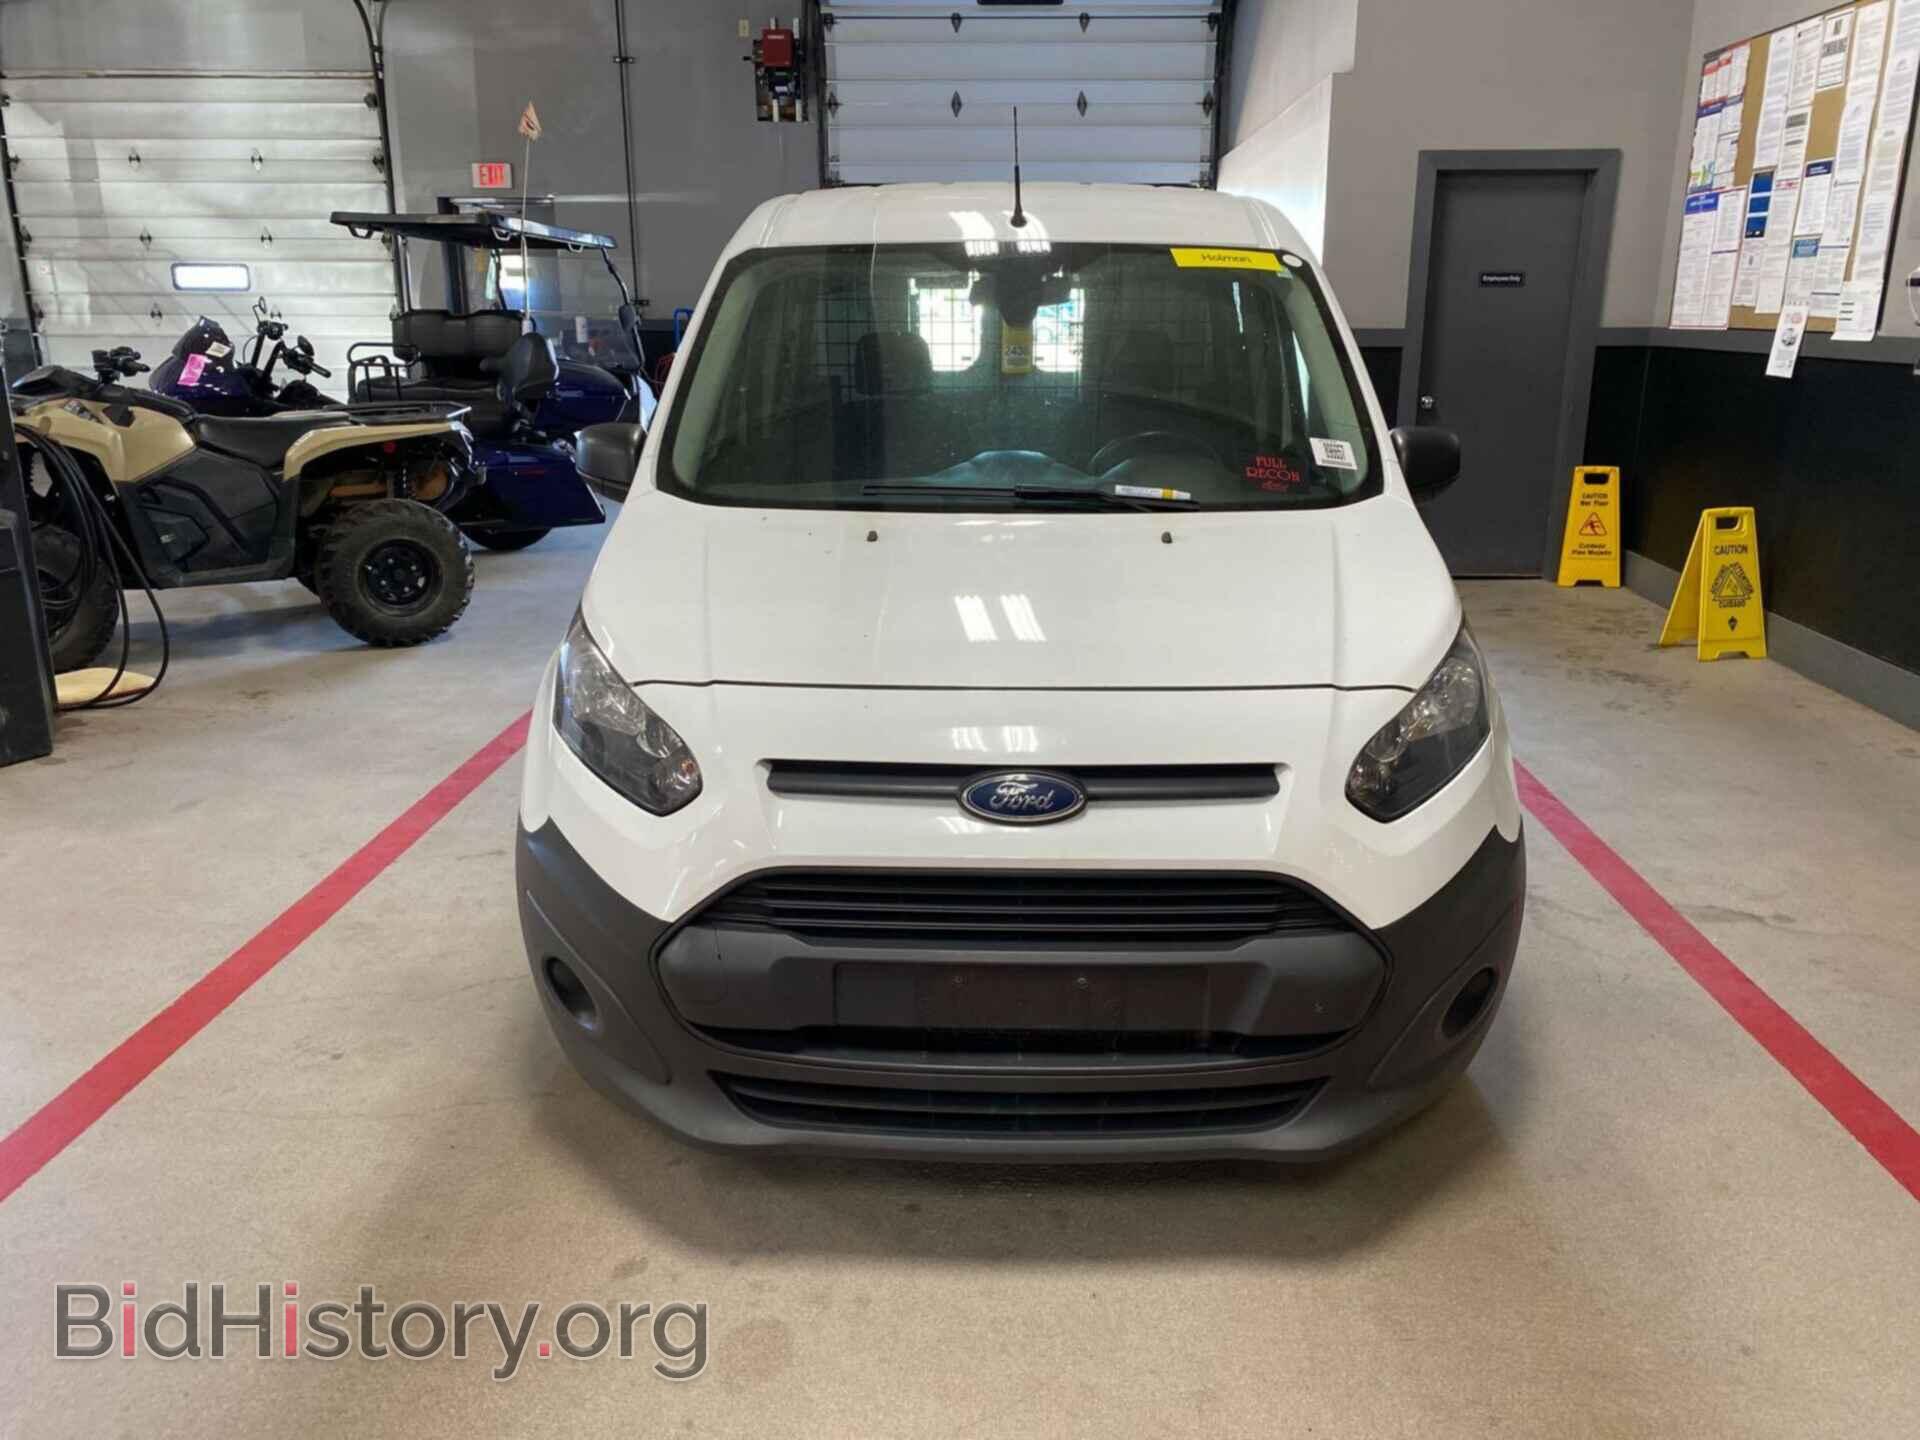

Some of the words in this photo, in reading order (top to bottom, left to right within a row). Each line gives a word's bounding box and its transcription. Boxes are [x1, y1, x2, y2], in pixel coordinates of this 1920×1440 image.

[480, 164, 505, 186] EXIT
[1713, 544, 1748, 555] CAUTION
[989, 781, 1055, 809] Ford
